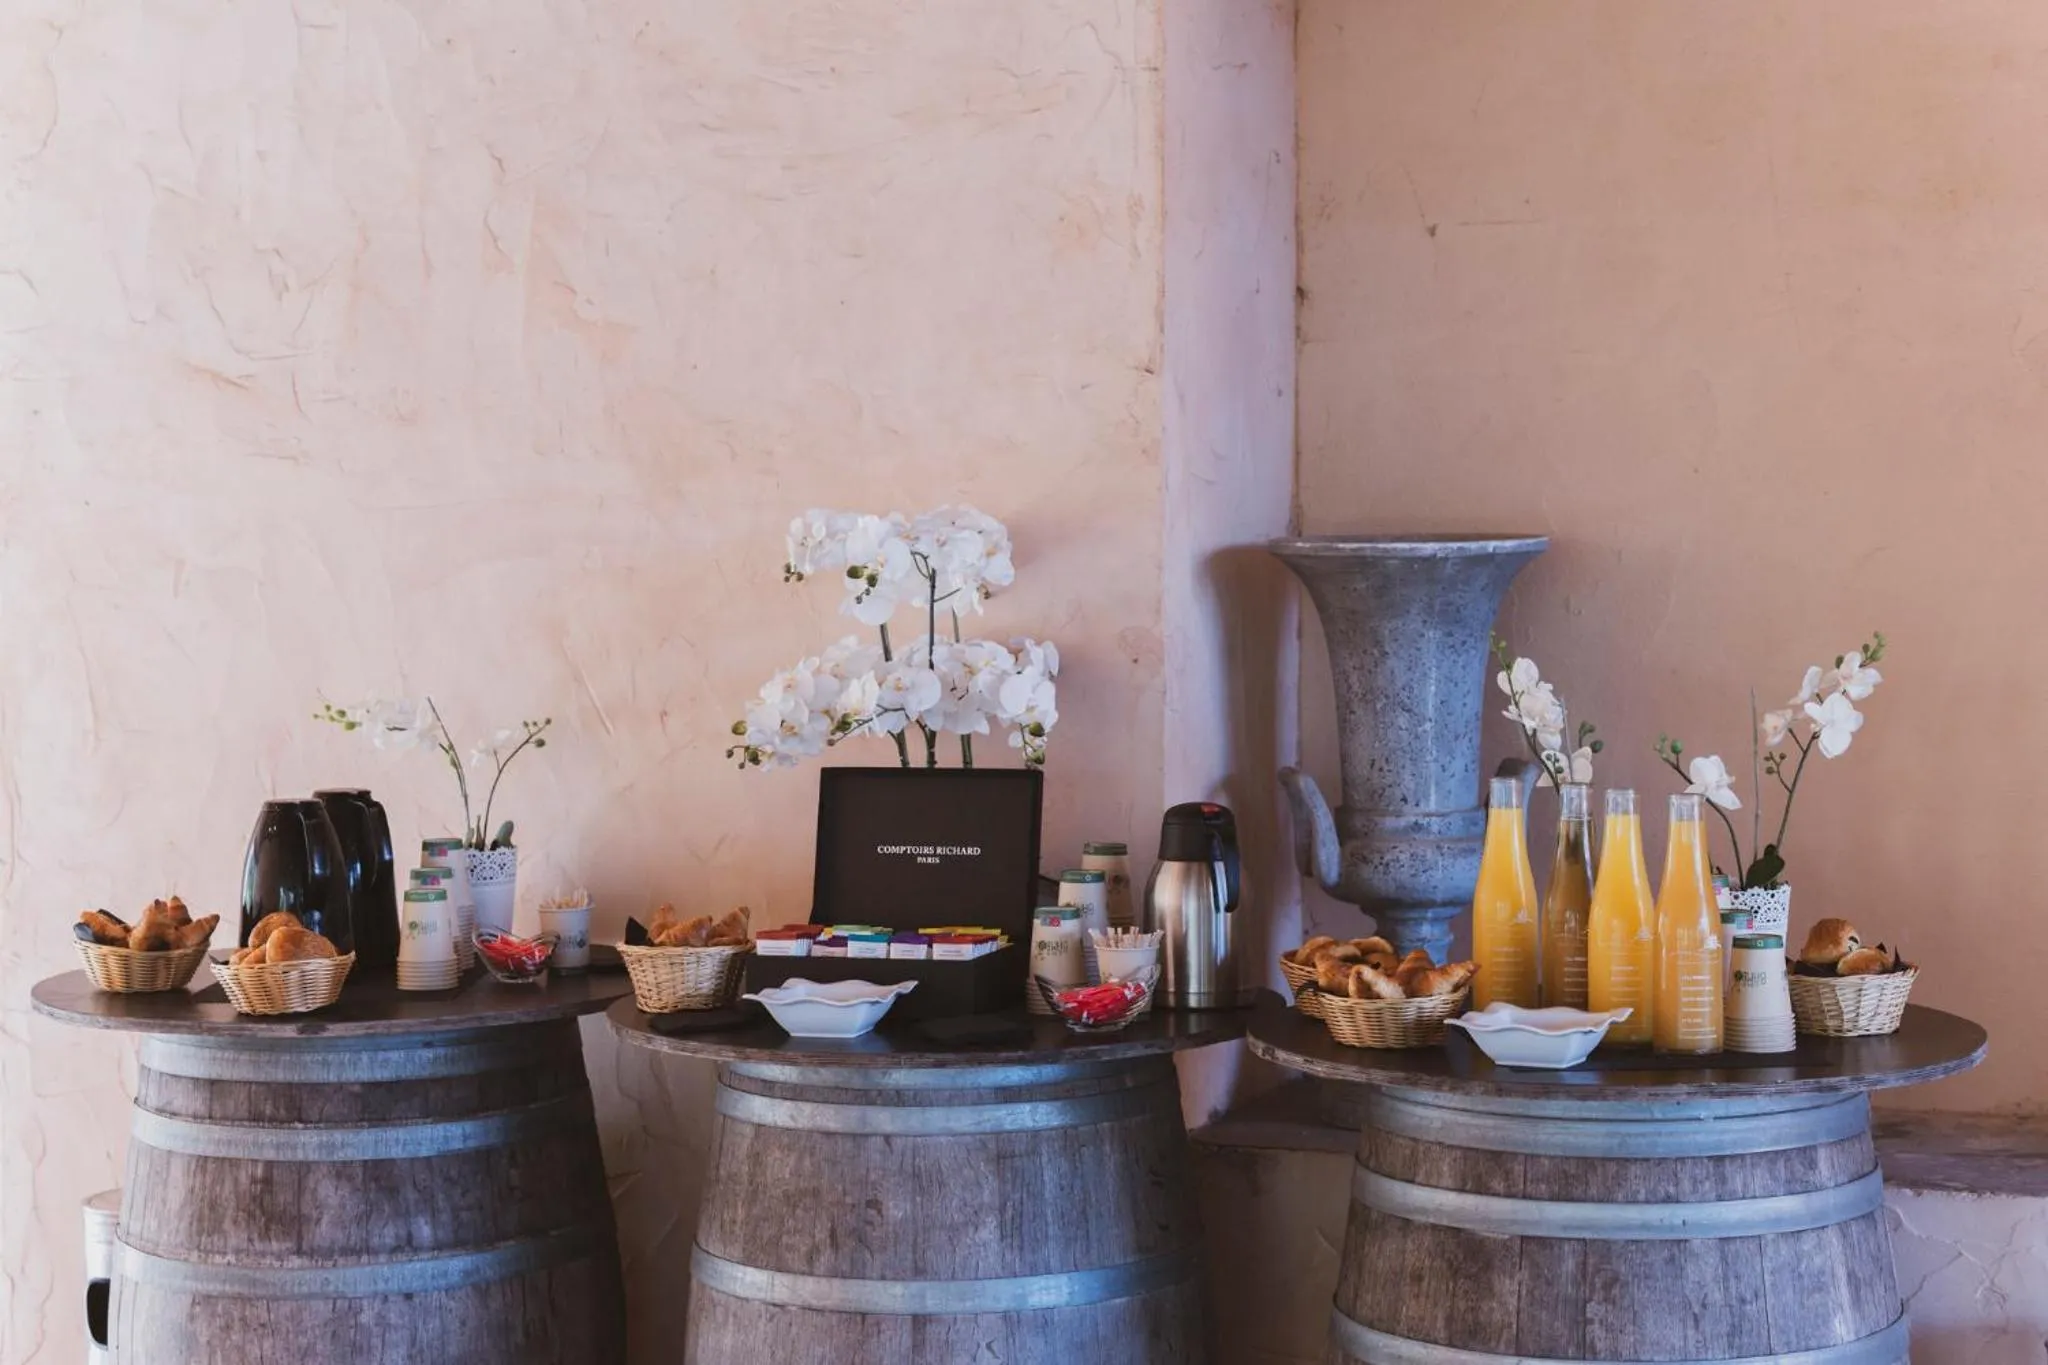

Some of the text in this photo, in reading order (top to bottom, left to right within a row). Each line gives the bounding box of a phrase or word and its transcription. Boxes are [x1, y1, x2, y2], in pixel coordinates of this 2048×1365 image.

[877, 845, 981, 855] COMPTOIRS RICHARD
[917, 856, 940, 864] PARIS
